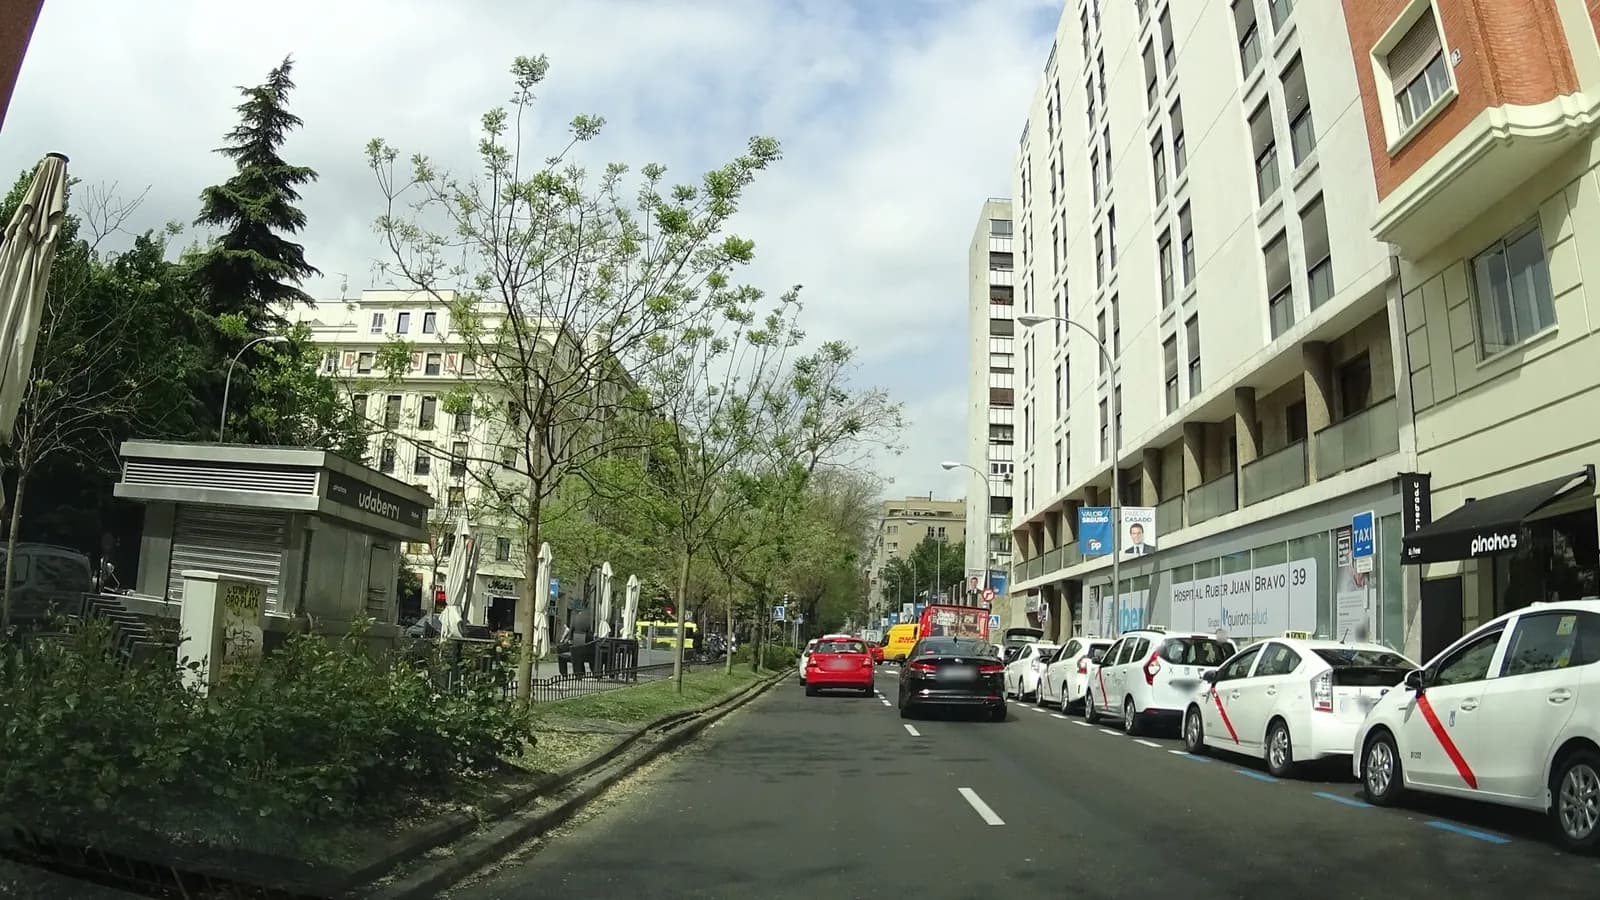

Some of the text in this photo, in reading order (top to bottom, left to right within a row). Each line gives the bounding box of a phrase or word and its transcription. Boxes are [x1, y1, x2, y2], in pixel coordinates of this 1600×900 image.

[358, 489, 400, 520] udaberri
[1091, 541, 1102, 550] PP
[1353, 527, 1373, 544] TAXI
[1230, 579, 1251, 595] JUAN
[1255, 574, 1286, 592] BRAVO
[1292, 568, 1306, 587] 39
